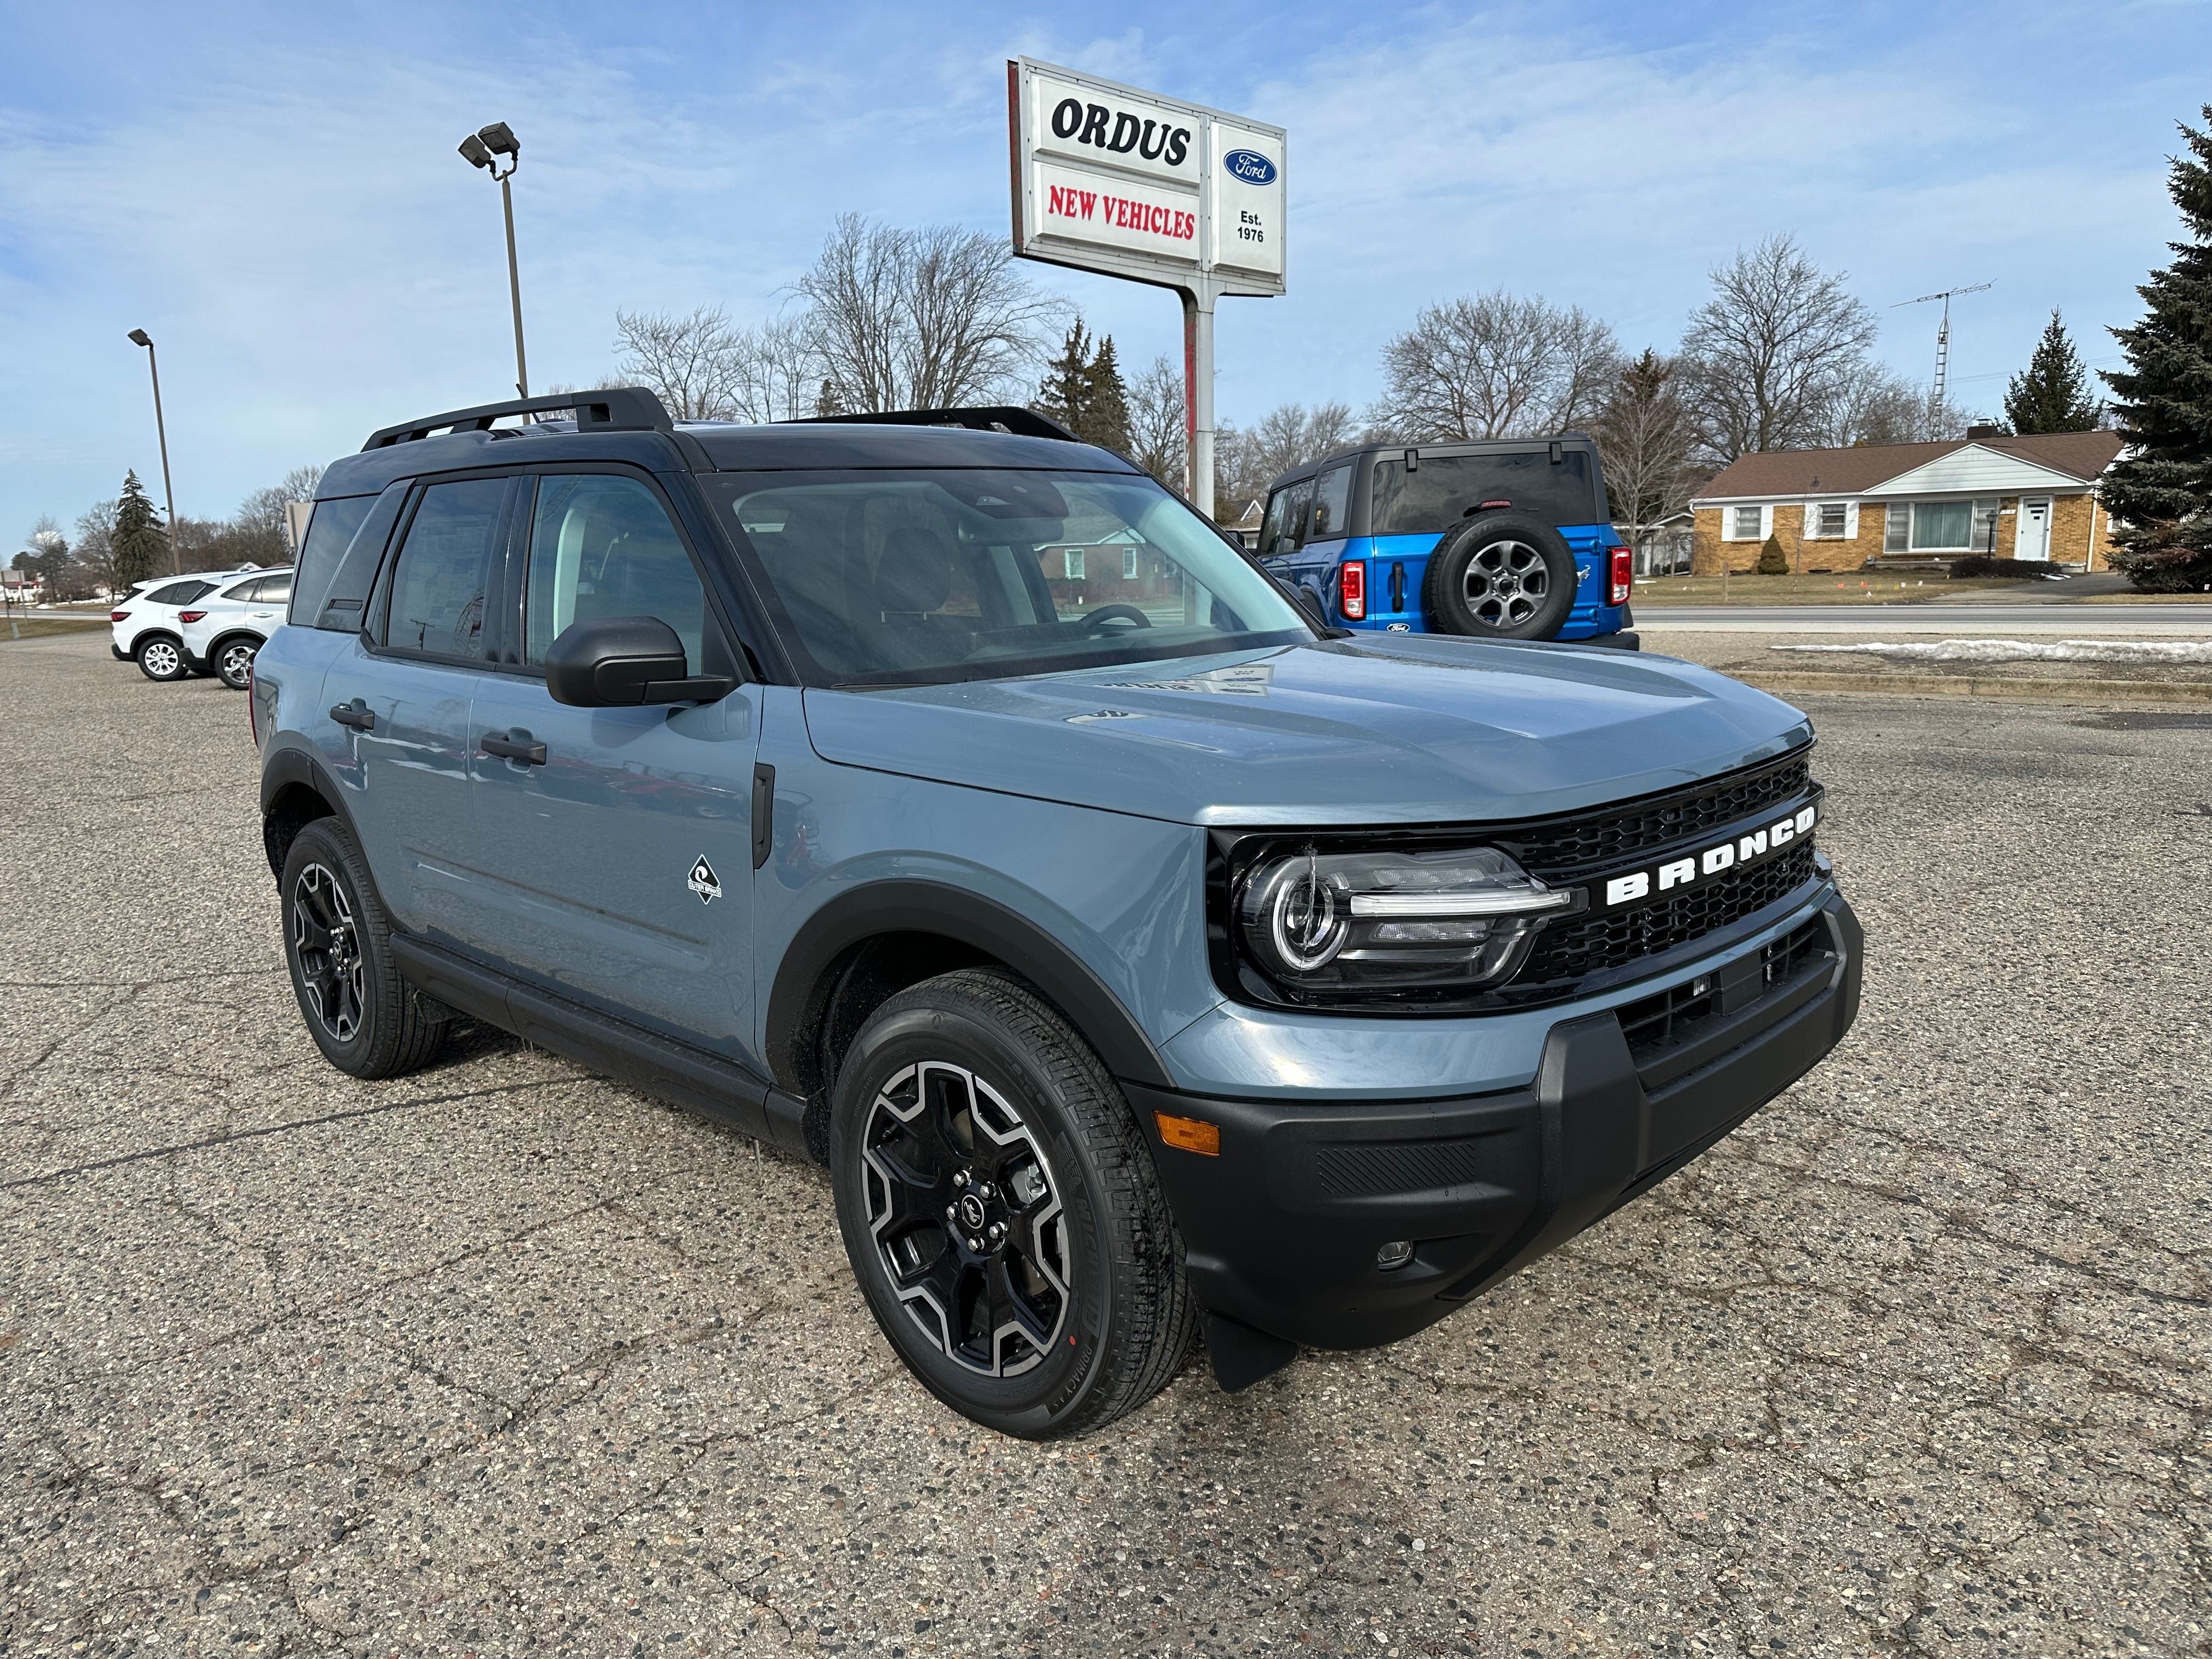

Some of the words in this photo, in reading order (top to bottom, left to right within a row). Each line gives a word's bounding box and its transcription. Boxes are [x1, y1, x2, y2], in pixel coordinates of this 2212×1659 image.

[1052, 98, 1190, 166] ORDUS
[1235, 154, 1267, 179] Ford
[1048, 185, 1097, 221] NEW
[1103, 196, 1195, 240] VEHICLES
[1240, 210, 1262, 226] Est.
[1237, 226, 1264, 242] 1976
[1606, 806, 1814, 906] BRONCO
[689, 882, 704, 891] OUTER
[704, 886, 720, 895] BANKS
[1064, 1343, 1093, 1396] PRIMACY
